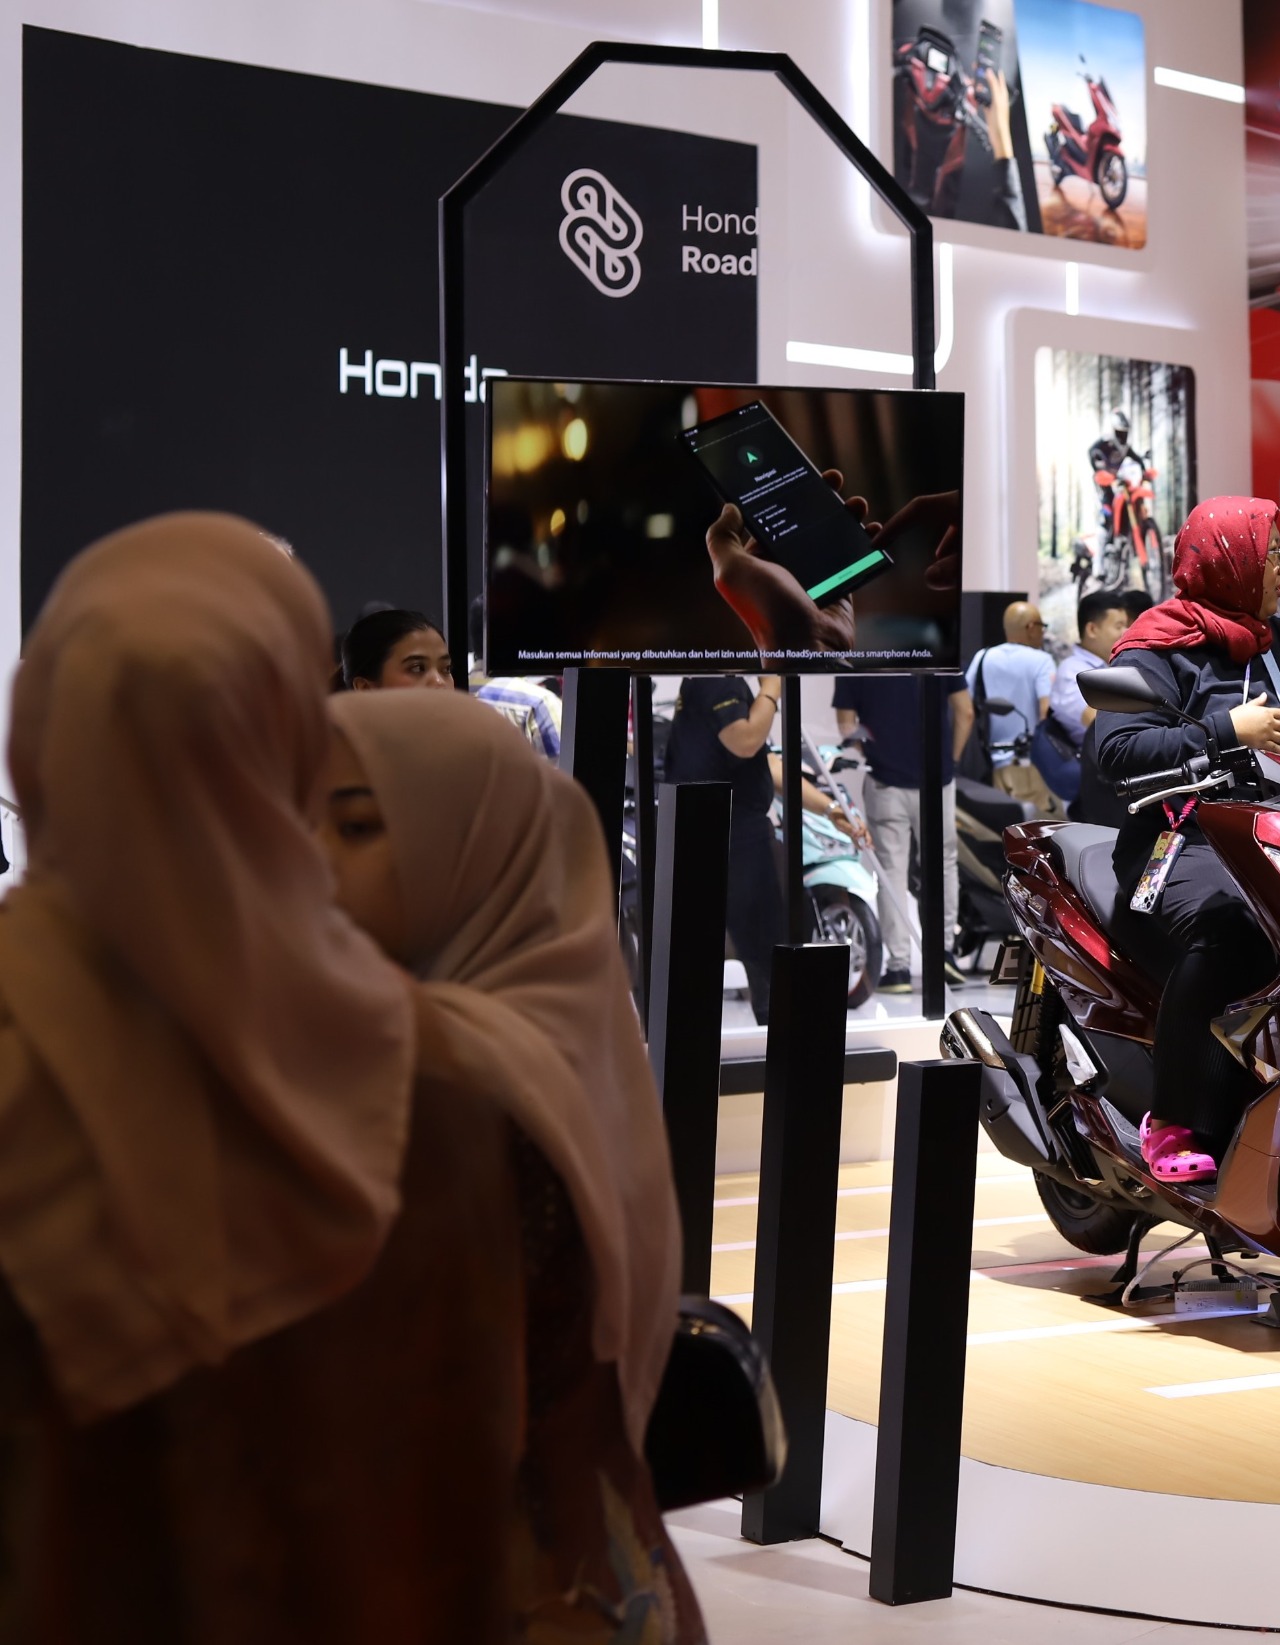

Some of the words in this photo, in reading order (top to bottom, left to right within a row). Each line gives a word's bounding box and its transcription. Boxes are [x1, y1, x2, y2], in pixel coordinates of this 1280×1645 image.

[681, 245, 757, 277] Road
[518, 650, 553, 659] Masukan
[583, 650, 620, 659] informasi
[621, 652, 641, 661] yang
[642, 650, 687, 659] dibutuhkan
[688, 650, 703, 659] dan
[704, 650, 719, 659] beri
[721, 650, 735, 658] izin
[736, 650, 758, 659] untuk
[760, 650, 785, 659] Honda
[786, 650, 823, 660] RoadSync
[824, 650, 865, 660] mengakses
[866, 650, 910, 660] smartphone
[911, 650, 933, 659] Anda.
